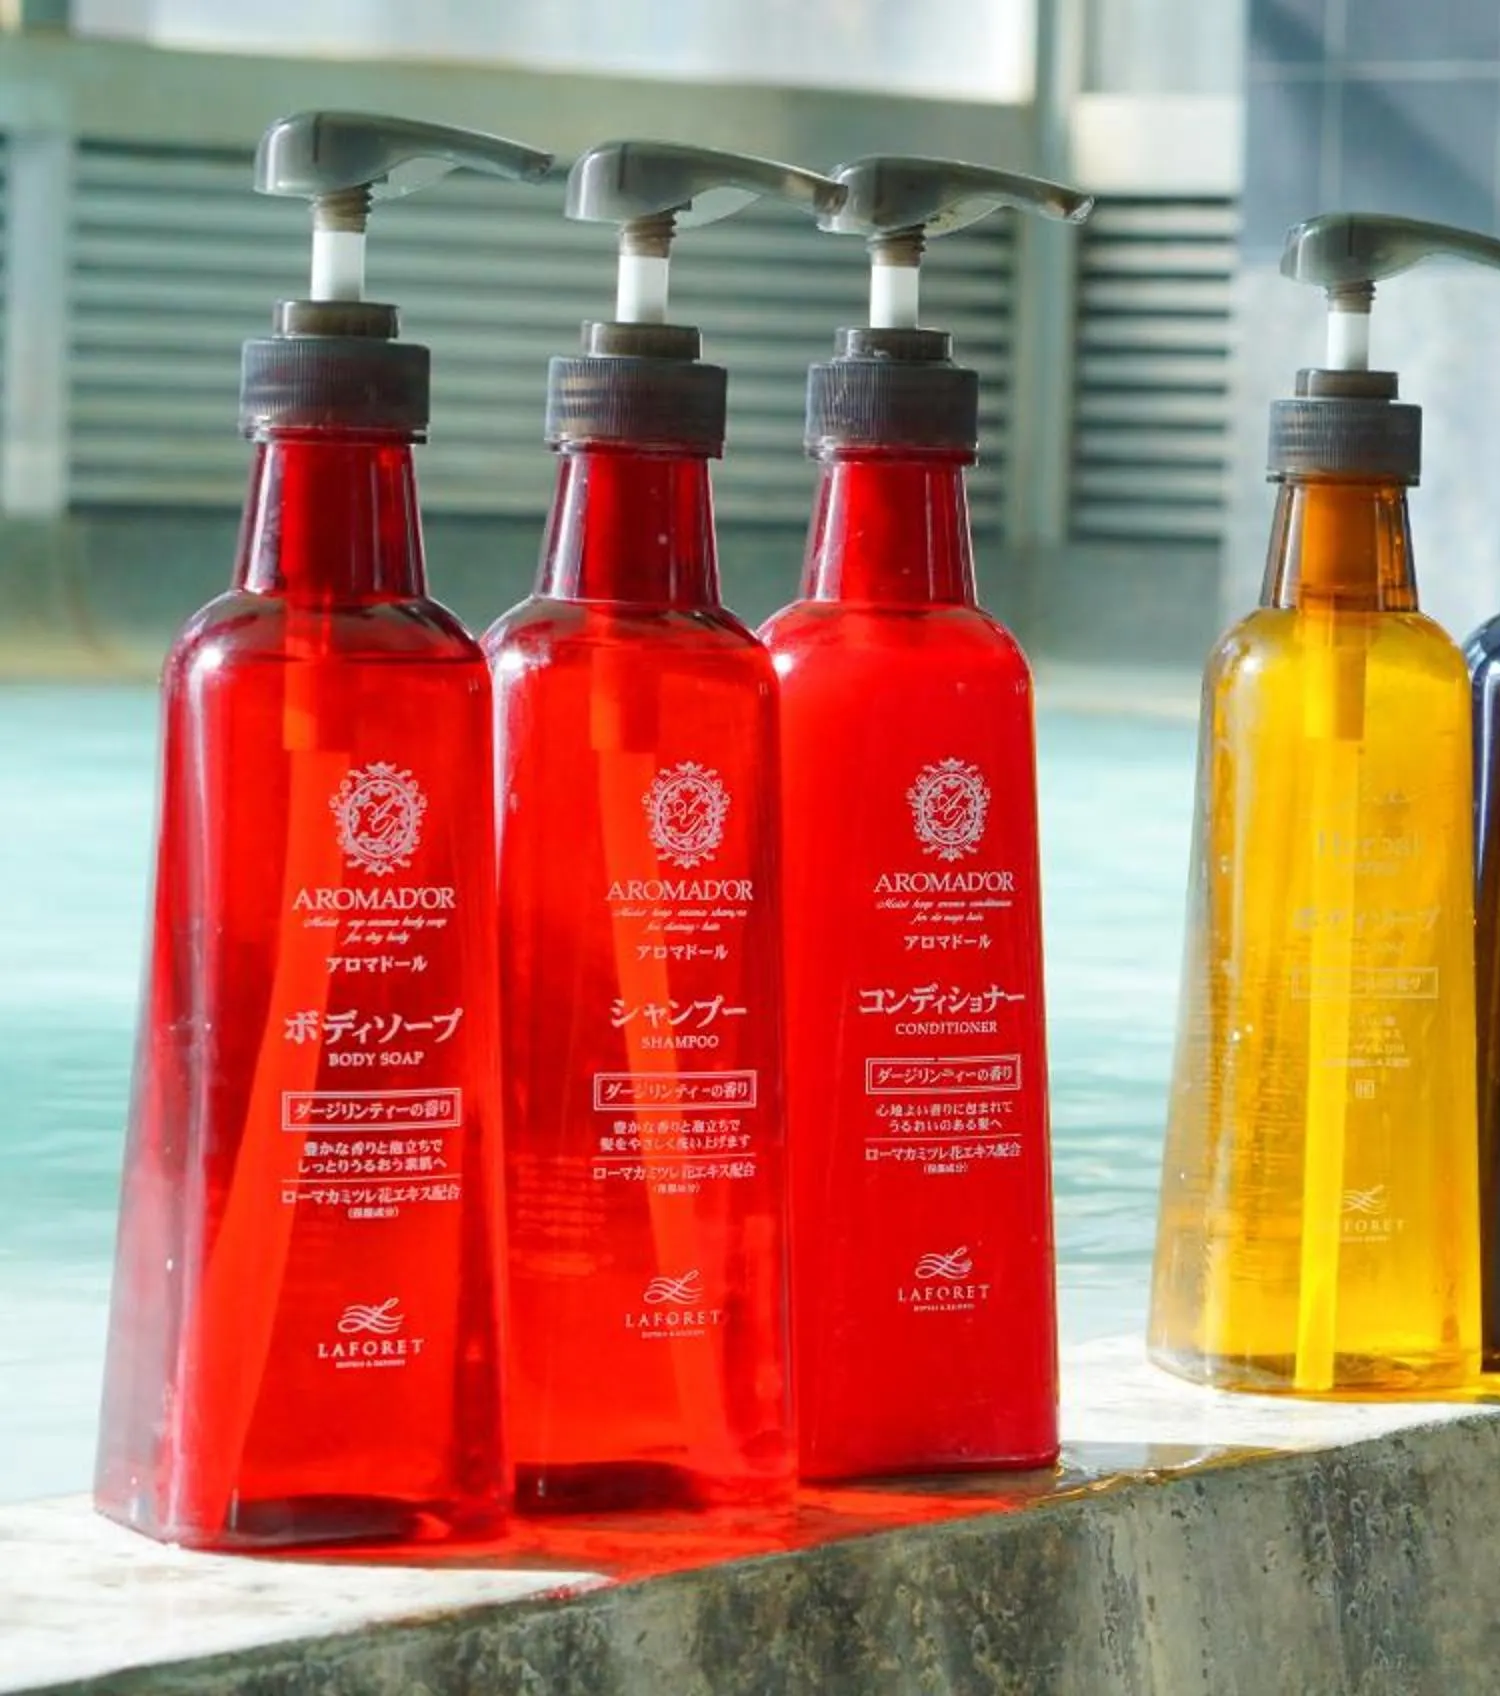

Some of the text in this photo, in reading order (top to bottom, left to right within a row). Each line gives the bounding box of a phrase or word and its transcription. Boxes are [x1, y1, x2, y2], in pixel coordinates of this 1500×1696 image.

[637, 943, 729, 961] アロマドール
[903, 933, 993, 951] アロマドール
[325, 955, 429, 974] アロマドール
[858, 982, 1026, 1015] コンディショナー
[610, 994, 748, 1029] シャンプー
[284, 1007, 464, 1046] ボディソープ
[895, 1019, 998, 1036] CONDITIONER
[641, 1034, 720, 1050] SHAMPOO
[328, 1050, 425, 1068] BODY SOAP
[604, 1081, 749, 1101] ダージリンティーの香り
[295, 1099, 452, 1121] ダージリンティーの香り
[897, 1283, 991, 1303] LAFORET
[624, 1309, 721, 1329] LAFORET
[317, 1338, 425, 1359] LAFORET
